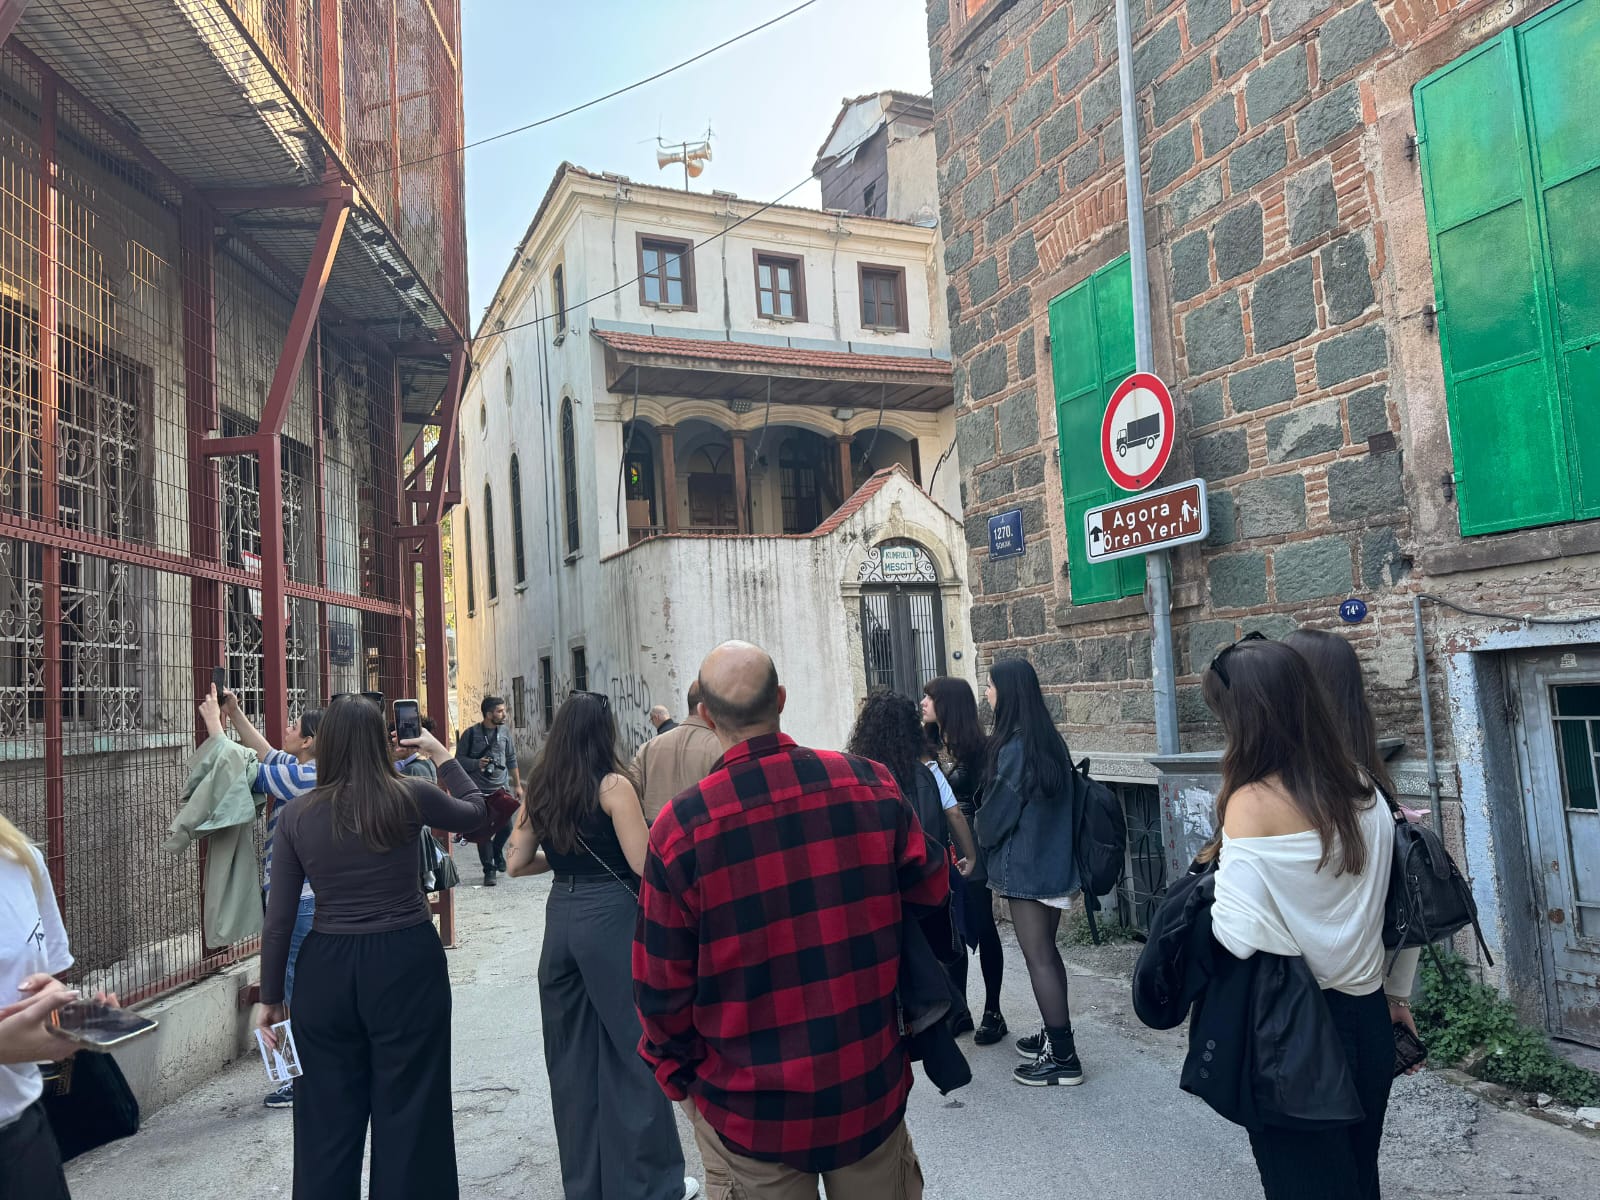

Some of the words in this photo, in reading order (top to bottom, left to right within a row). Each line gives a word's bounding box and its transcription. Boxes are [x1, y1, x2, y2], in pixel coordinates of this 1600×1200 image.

[1112, 503, 1170, 530] Agora
[1103, 530, 1142, 550] Ören
[1147, 518, 1183, 540] Yeri
[884, 561, 913, 572] MESCİT
